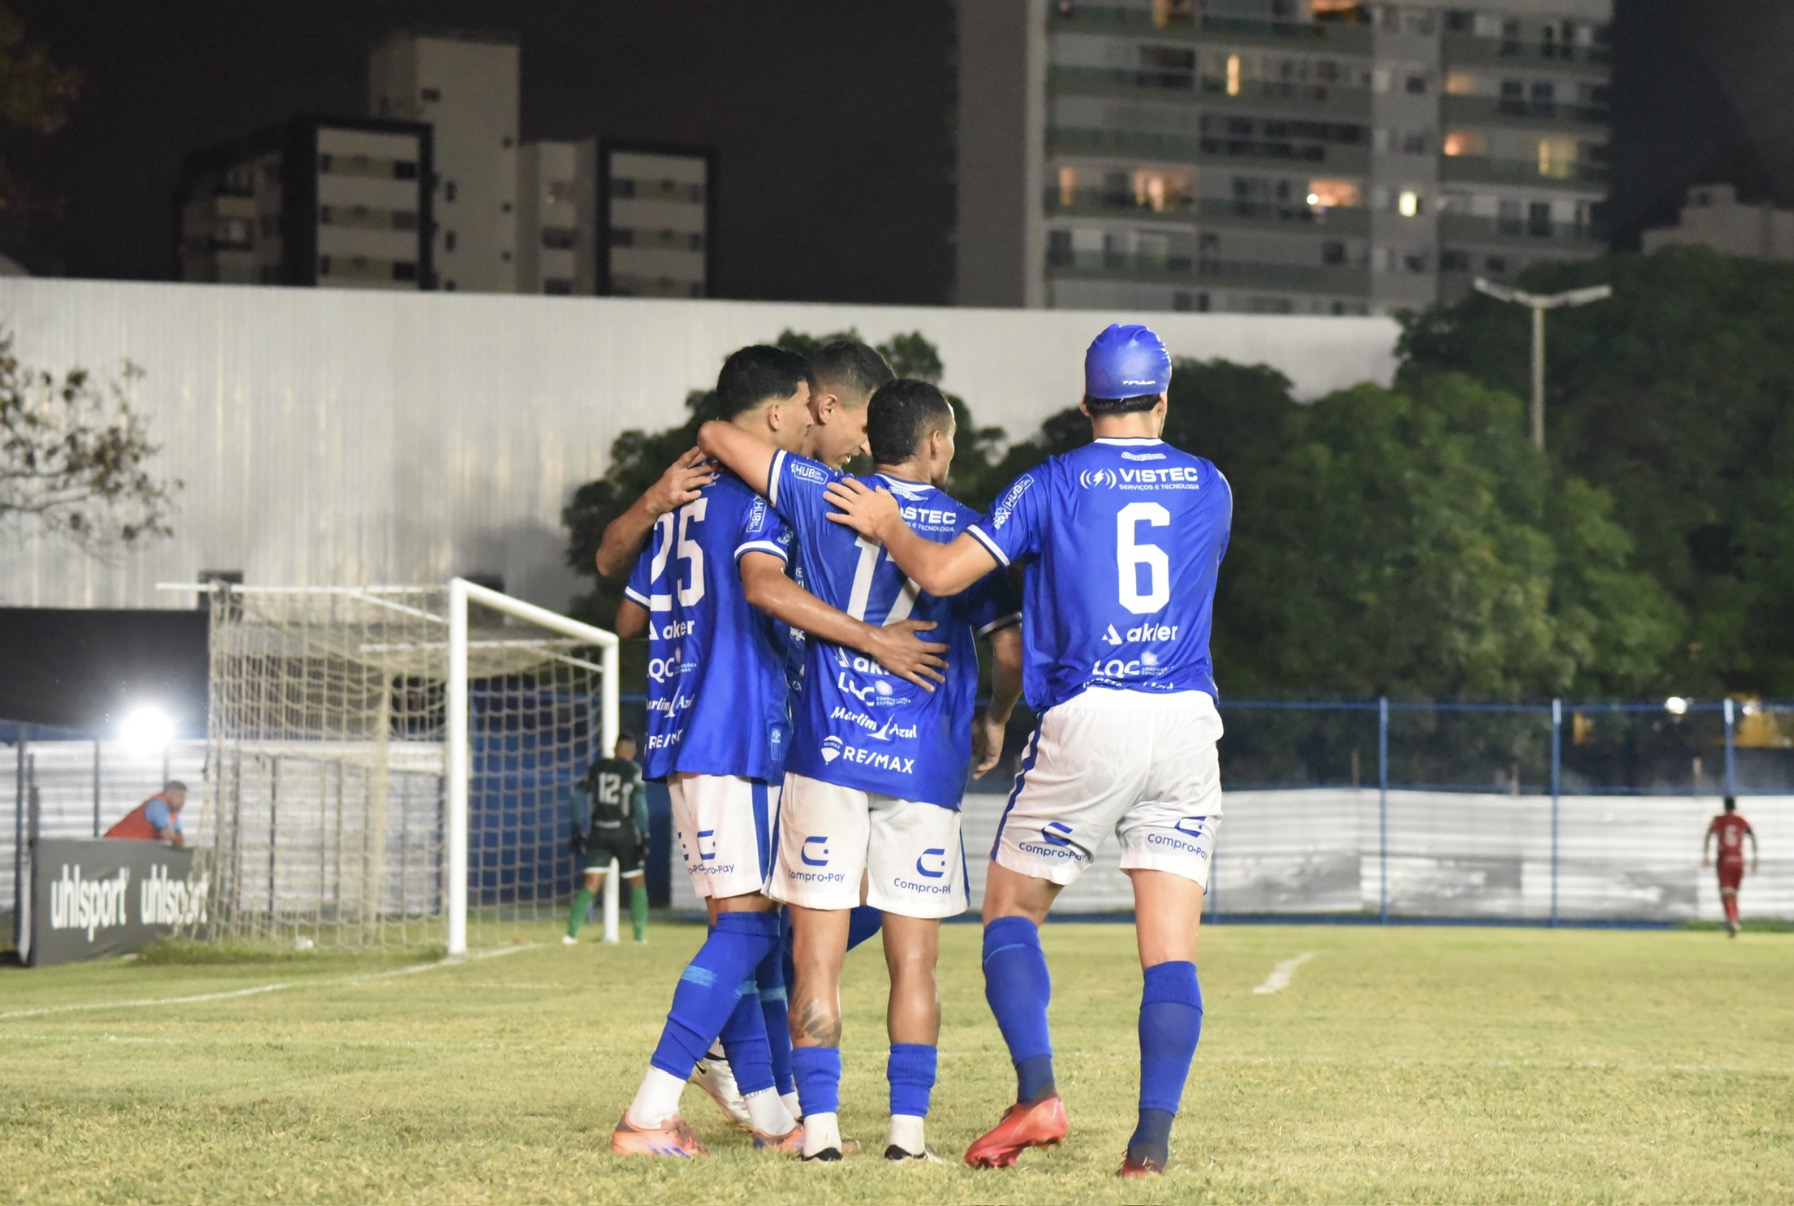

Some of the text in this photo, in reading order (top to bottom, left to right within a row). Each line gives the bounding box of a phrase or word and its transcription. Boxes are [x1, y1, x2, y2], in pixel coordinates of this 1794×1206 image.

[1118, 467, 1198, 483] VISTEC
[1161, 483, 1199, 491] TECNOLOGIA
[1005, 484, 1022, 507] HUB
[650, 497, 708, 611] 25
[1117, 502, 1170, 614] 6
[1092, 659, 1139, 678] LQC
[830, 706, 917, 738] Marlim Azul
[843, 746, 915, 774] RE/MAX
[599, 772, 620, 805] 12
[51, 864, 127, 942] uhlsport
